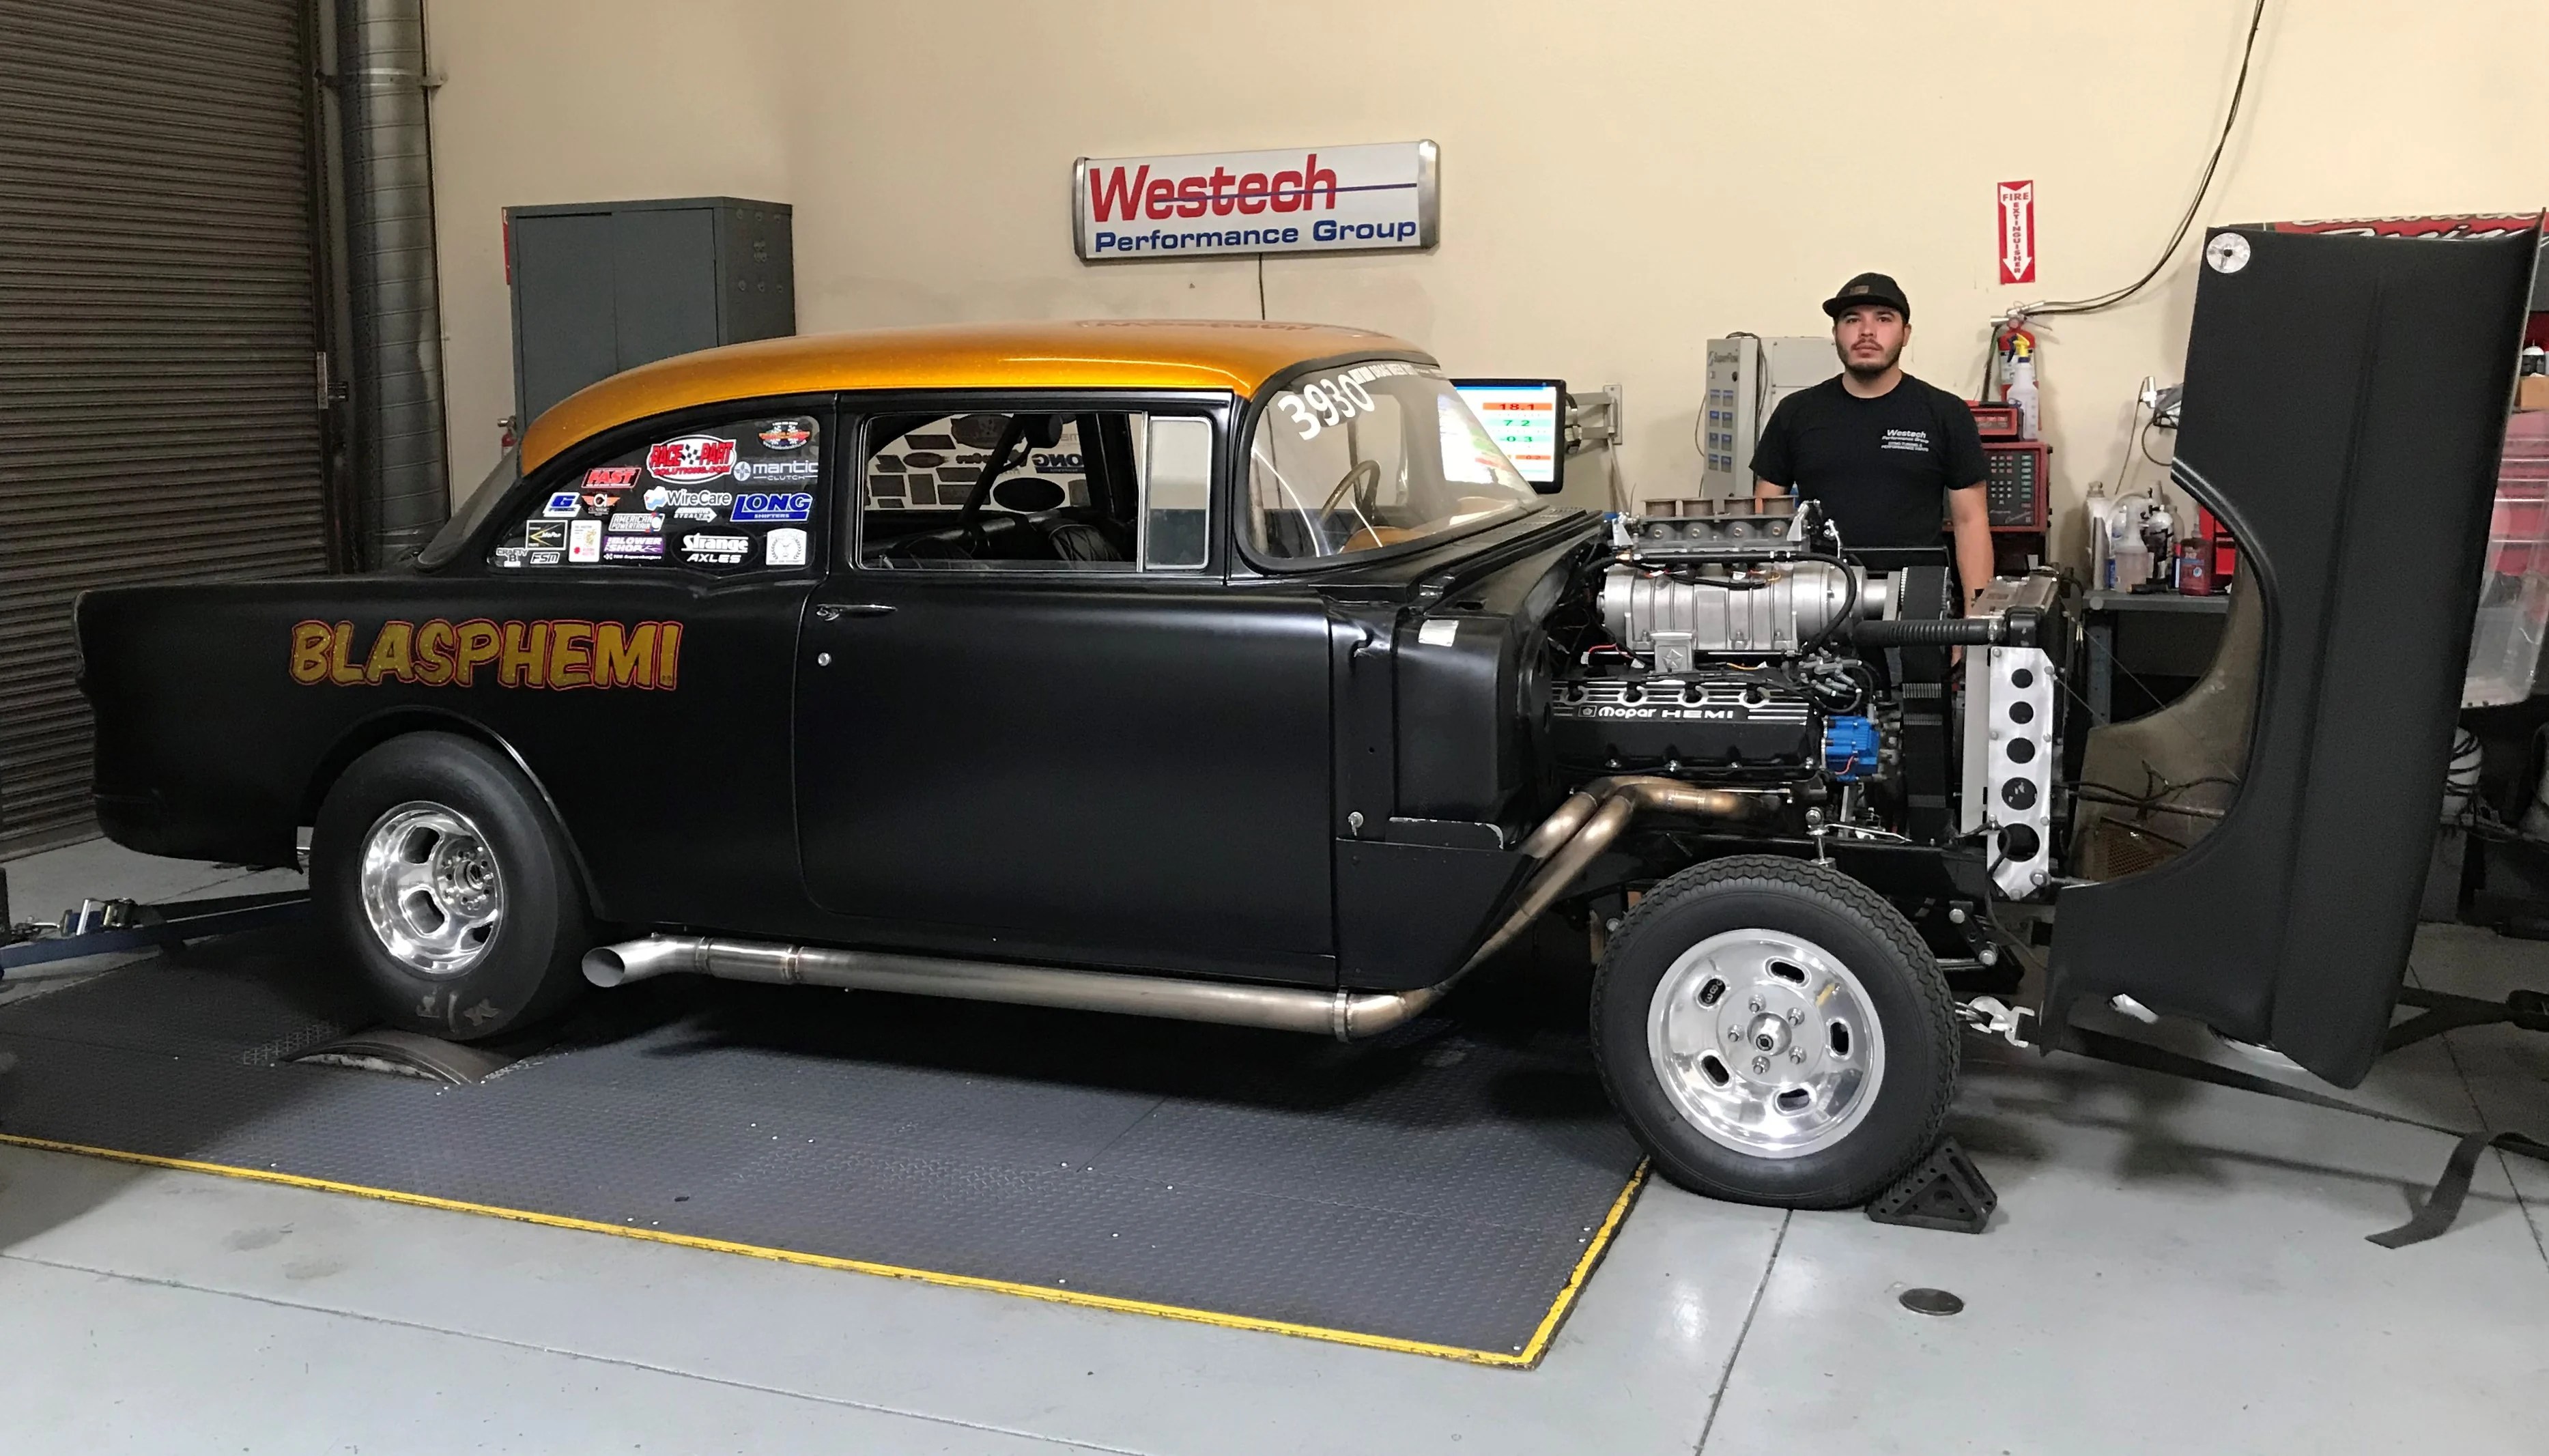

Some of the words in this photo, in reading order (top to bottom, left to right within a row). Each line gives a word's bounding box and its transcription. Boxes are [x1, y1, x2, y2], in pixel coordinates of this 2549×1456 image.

[1090, 154, 1336, 223] Westech
[2002, 192, 2030, 201] FIRE
[1095, 227, 1298, 253] Performance
[1313, 220, 1416, 242] Group
[2012, 202, 2021, 273] EXTINGUISHER
[1278, 375, 1374, 440] 3930
[1887, 429, 1926, 438] Westech
[649, 444, 684, 467] RACE
[699, 442, 735, 465] PART
[753, 460, 818, 474] mantic
[587, 470, 636, 483] FAST
[667, 490, 730, 504] WireCare
[730, 493, 813, 522] LONG
[611, 537, 662, 545] BLOWER
[681, 532, 749, 553] Strange
[532, 553, 559, 562] FSM
[687, 554, 741, 563] AXLES
[289, 619, 683, 690] BLASPHEMI
[1598, 706, 1657, 718] Mopar
[1662, 710, 1733, 719] HEMI
